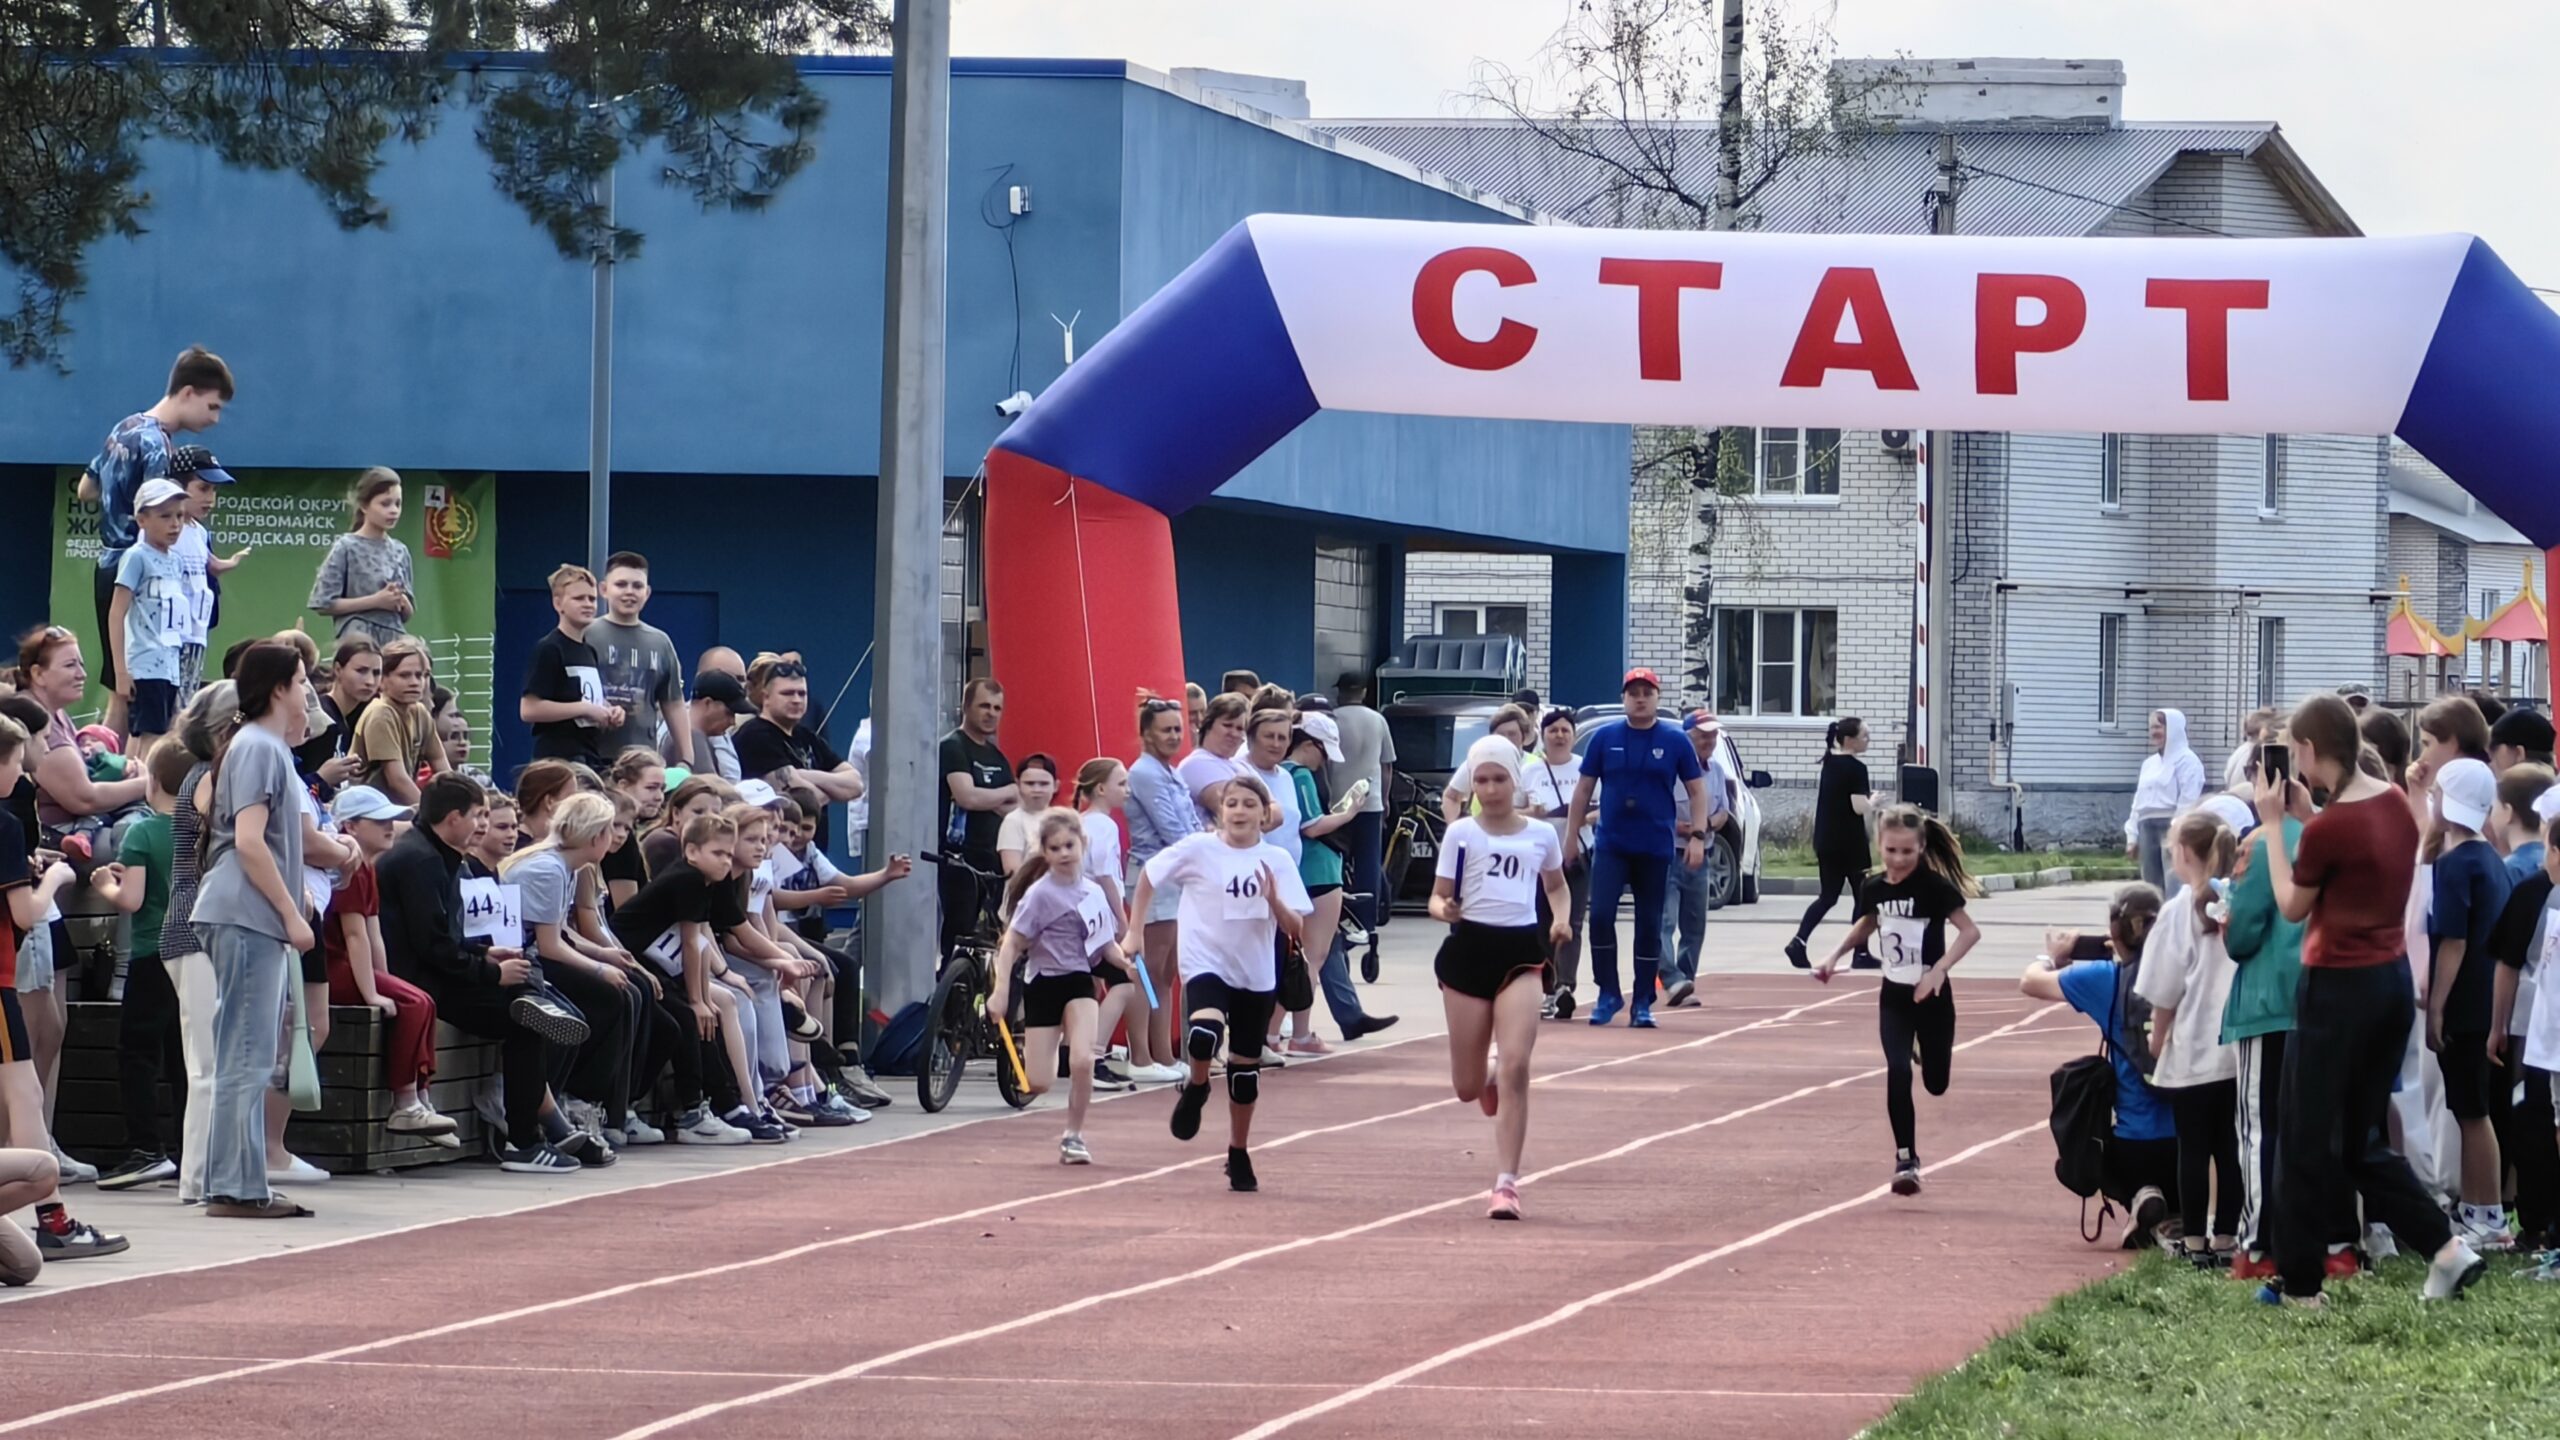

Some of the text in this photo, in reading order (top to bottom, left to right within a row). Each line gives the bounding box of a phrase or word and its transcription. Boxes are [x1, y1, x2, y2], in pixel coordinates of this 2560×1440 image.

[1412, 246, 2270, 402] СТАРТ
[216, 495, 294, 511] РОДСКОЙ
[225, 513, 335, 529] ПЕРВОМАЙСК
[209, 530, 305, 547] ГОРОДСКАЯ
[1487, 853, 1519, 880] 20
[1226, 874, 1257, 898] 46
